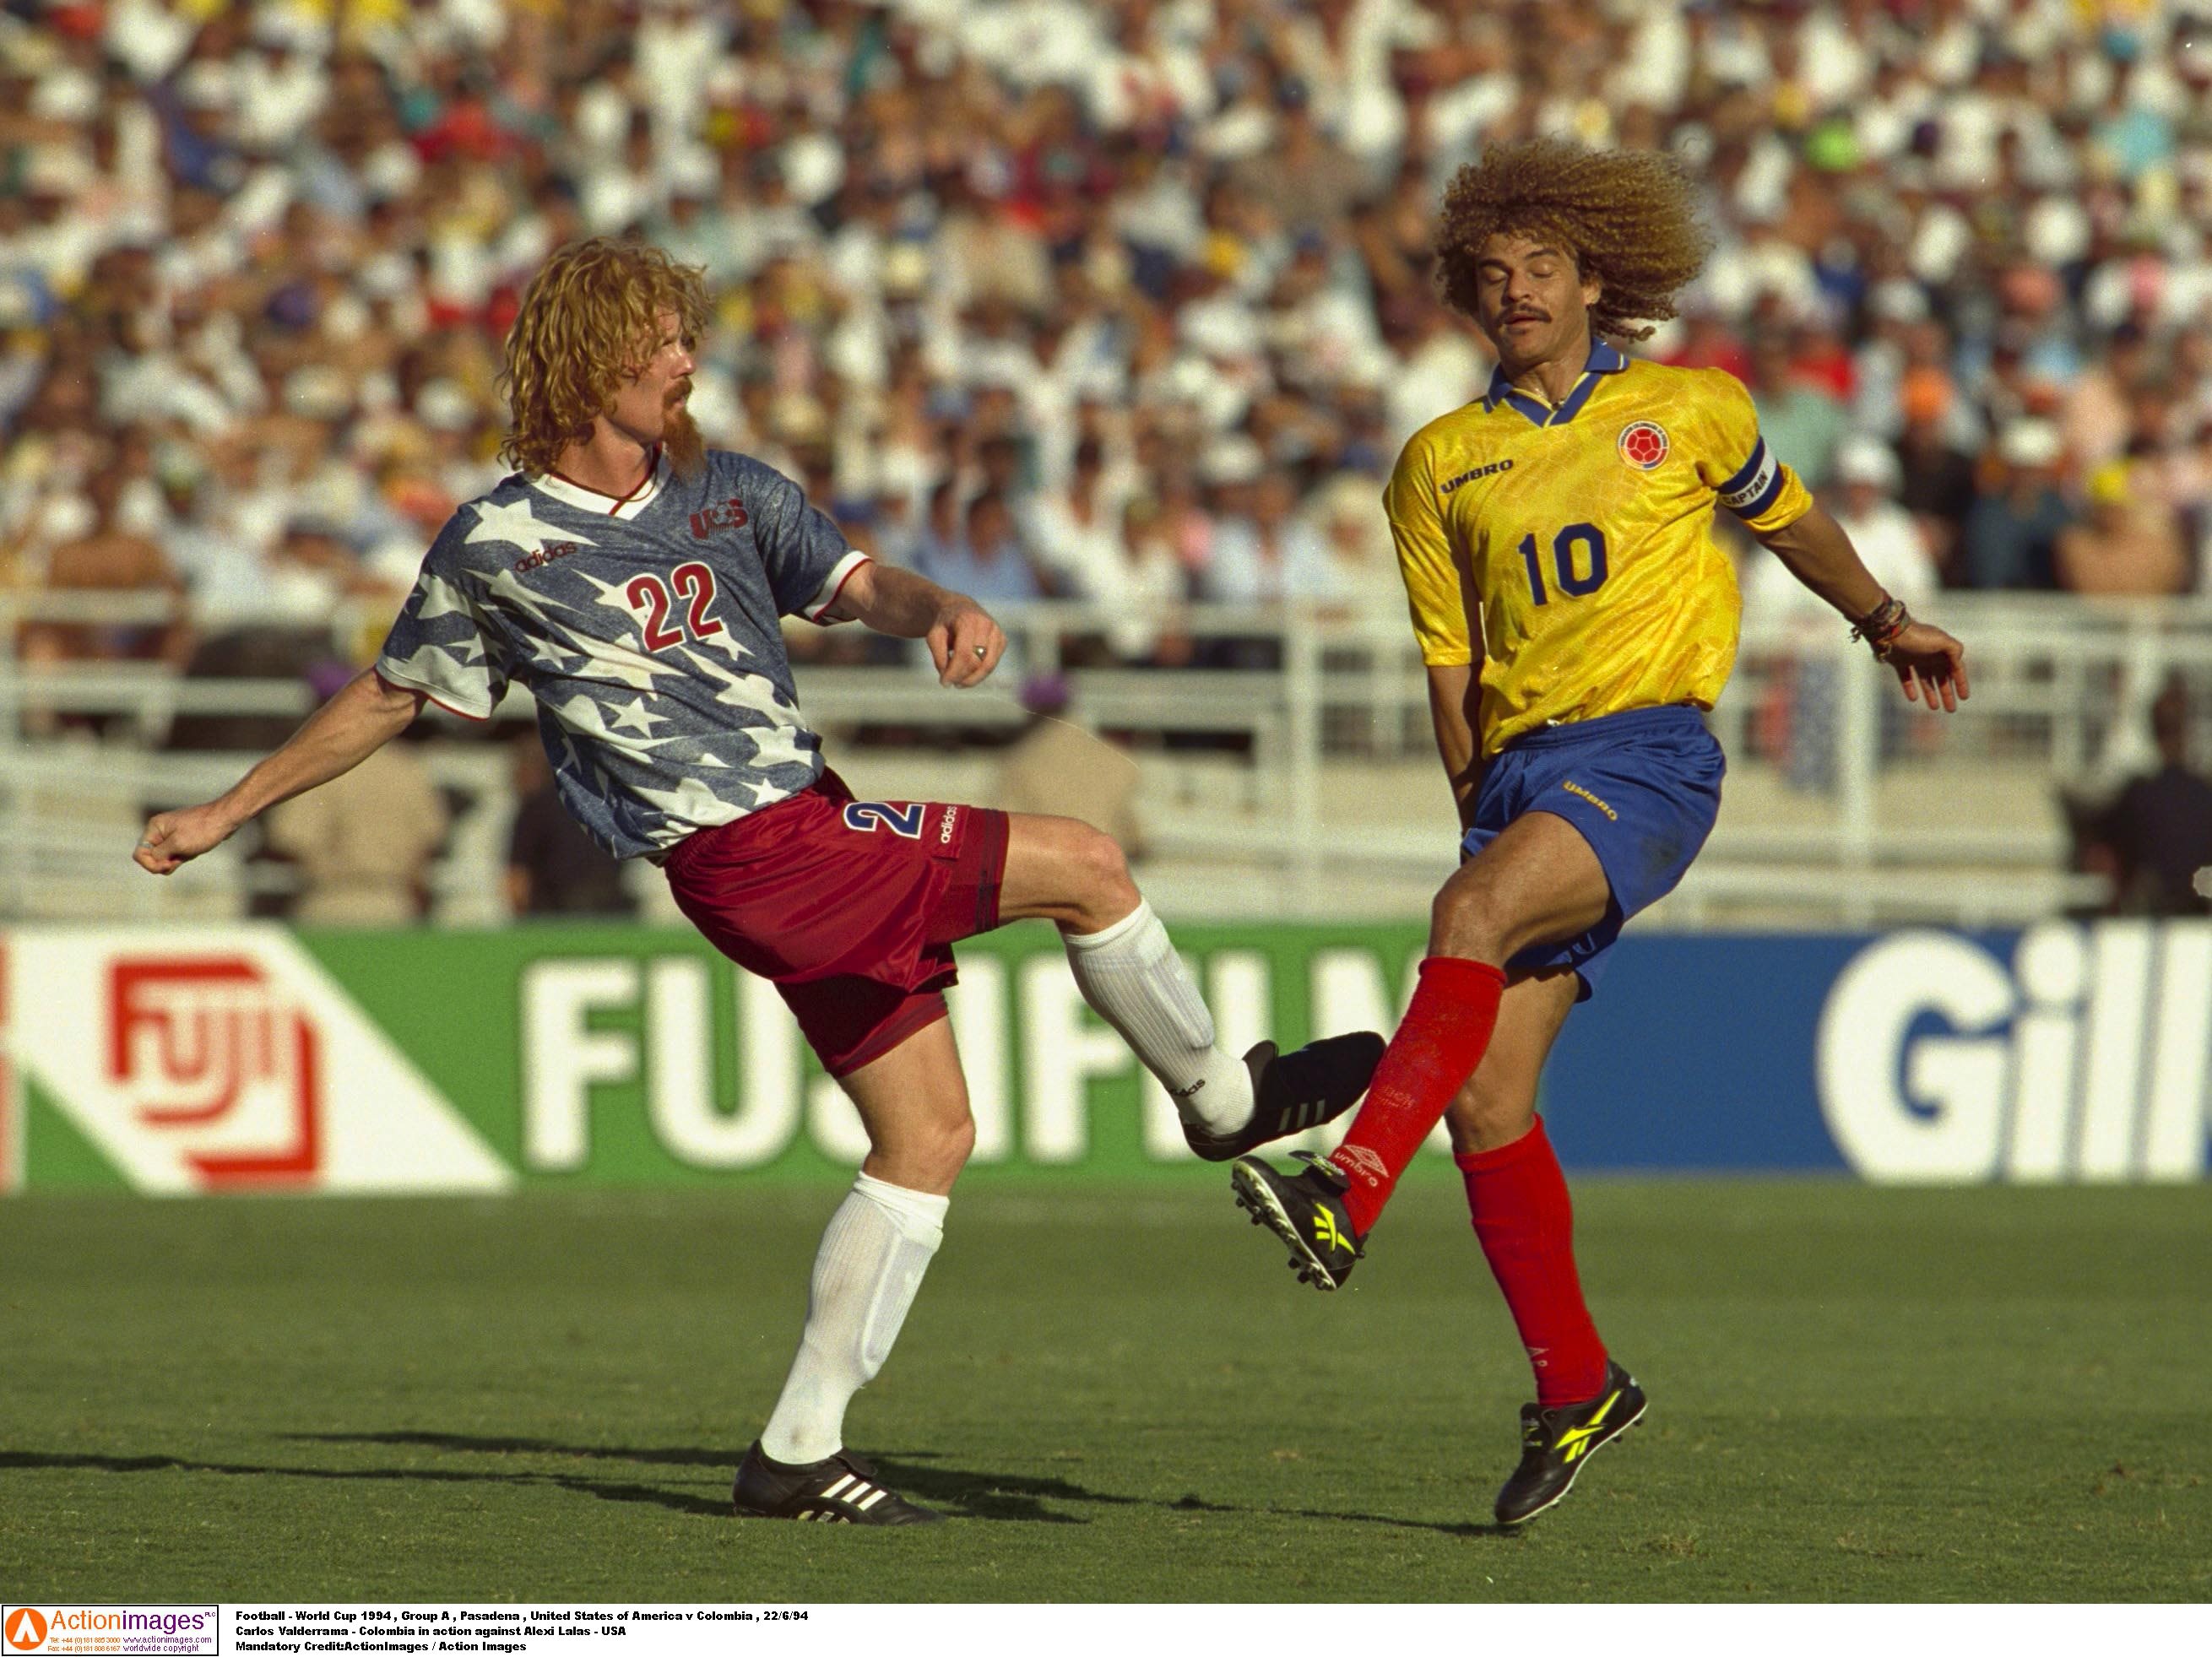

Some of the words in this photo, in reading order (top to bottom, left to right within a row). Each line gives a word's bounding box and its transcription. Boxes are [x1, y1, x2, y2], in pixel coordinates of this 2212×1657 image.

[1440, 459, 1514, 494] UMBRO
[514, 540, 577, 573] adidas
[1518, 522, 1609, 606] 10
[626, 560, 724, 653] 22
[940, 804, 957, 844] adidas
[1335, 1152, 1378, 1188] umbro
